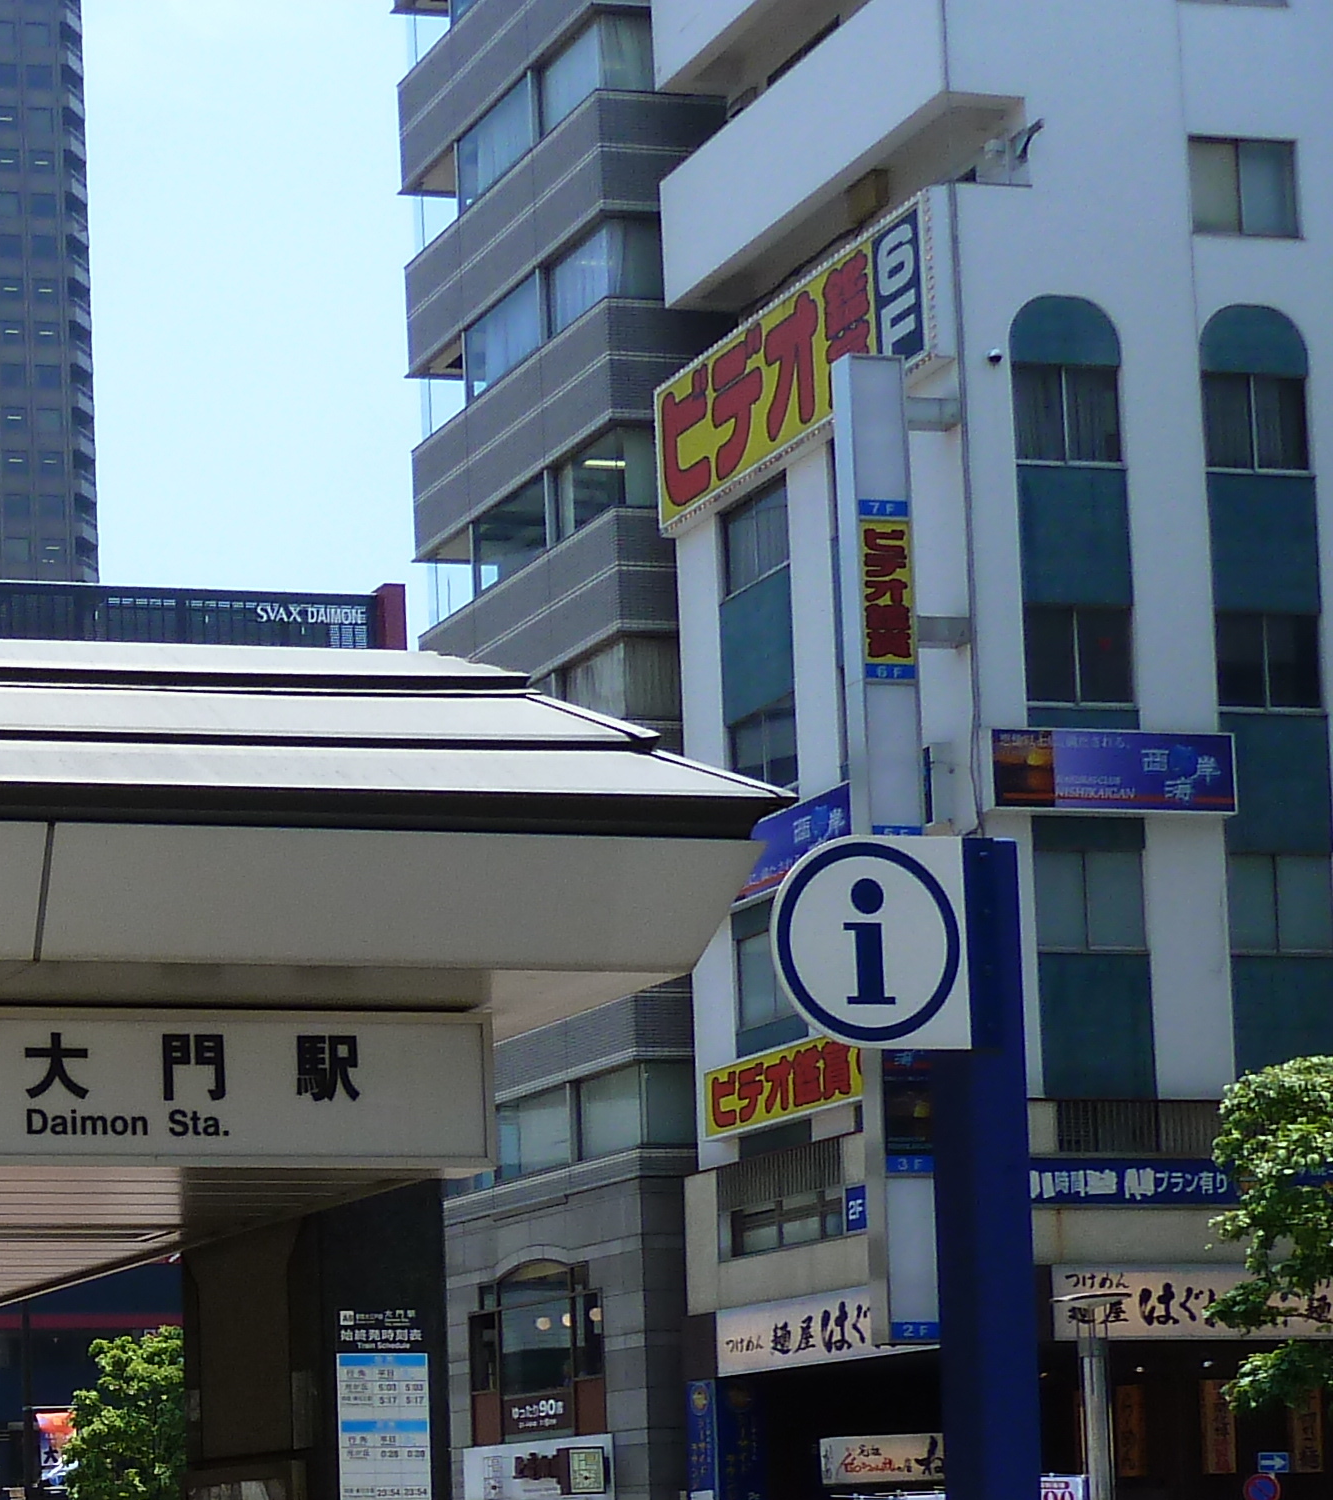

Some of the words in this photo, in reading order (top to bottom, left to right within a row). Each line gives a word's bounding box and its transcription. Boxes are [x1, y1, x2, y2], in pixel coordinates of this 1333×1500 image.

[867, 502, 895, 514] 7F
[255, 604, 303, 624] SVAX
[307, 606, 367, 626] DAIMON
[875, 666, 905, 678] 6F
[23, 1030, 363, 1104] 大門駅
[25, 1108, 149, 1138] Daimon
[167, 1108, 233, 1138] Sta.
[897, 1158, 923, 1170] 3F
[847, 1200, 865, 1220] 2F
[1065, 1272, 1131, 1290] つけめん
[339, 1328, 423, 1342] 始終発時刻表
[903, 1324, 929, 1338] 2F
[357, 1342, 377, 1350] Train
[377, 1342, 411, 1350] Schedule
[725, 1336, 765, 1354] つけめん
